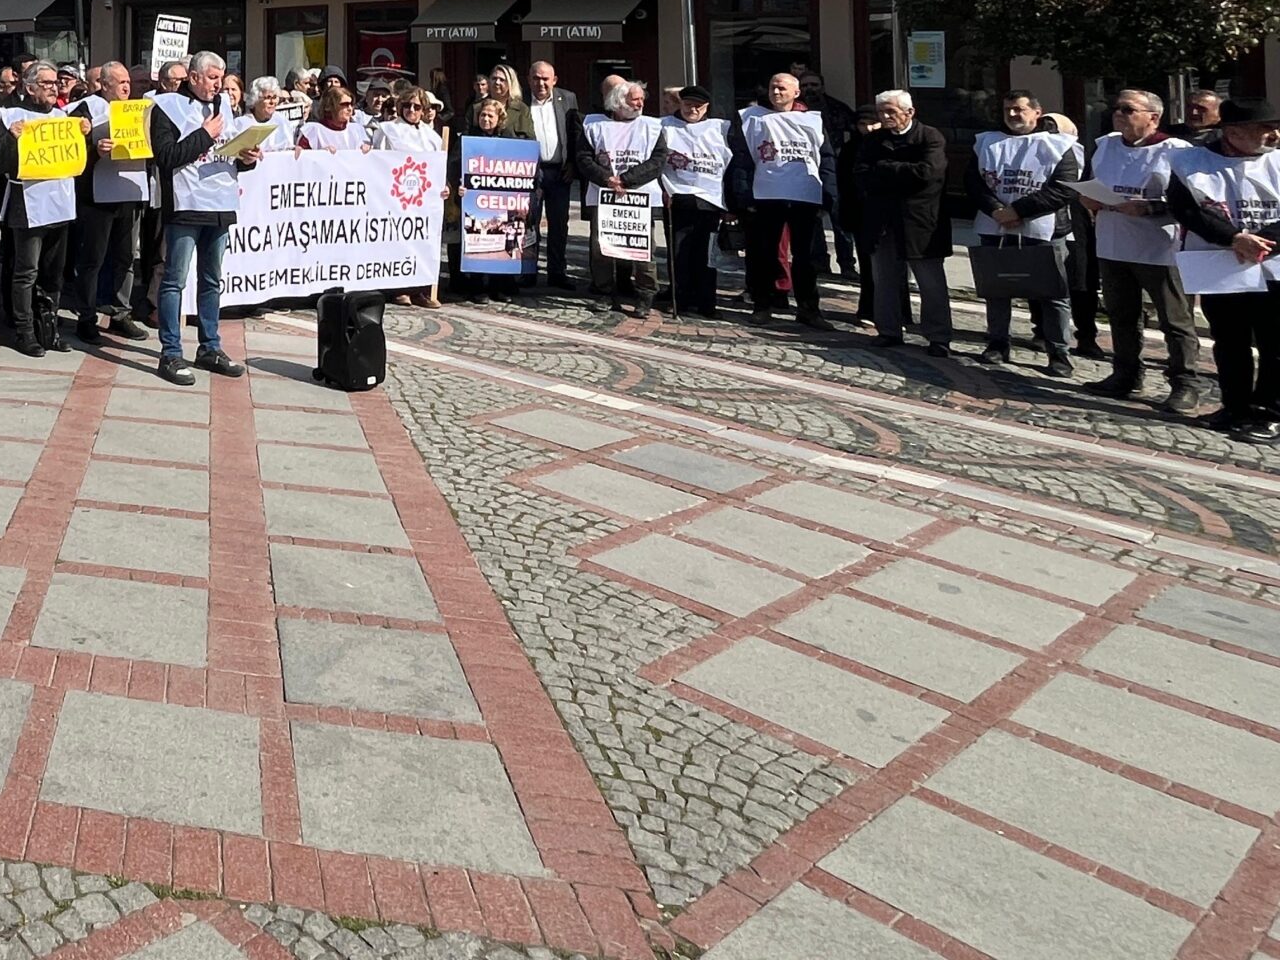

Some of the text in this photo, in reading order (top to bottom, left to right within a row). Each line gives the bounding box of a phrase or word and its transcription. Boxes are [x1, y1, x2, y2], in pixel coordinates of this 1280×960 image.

[426, 27, 478, 39] PTT (ATM)
[540, 25, 601, 39] PTT (ATM)
[30, 121, 75, 143] YETER
[25, 143, 80, 166] ARTIK!
[468, 156, 537, 177] PİJAMAYI
[470, 175, 535, 190] ÇIKARDIK
[271, 175, 367, 210] EMEKLİLER
[603, 192, 613, 204] 17
[476, 193, 531, 212] GELDİK
[612, 208, 641, 220] EMEKLİ
[226, 211, 430, 255] ANCA YAŞAMAK İSTİYOR!
[601, 219, 648, 232] BİRLEŞEREK
[219, 256, 417, 294] DİRNE EMEKLİLER DERNEĞİ
